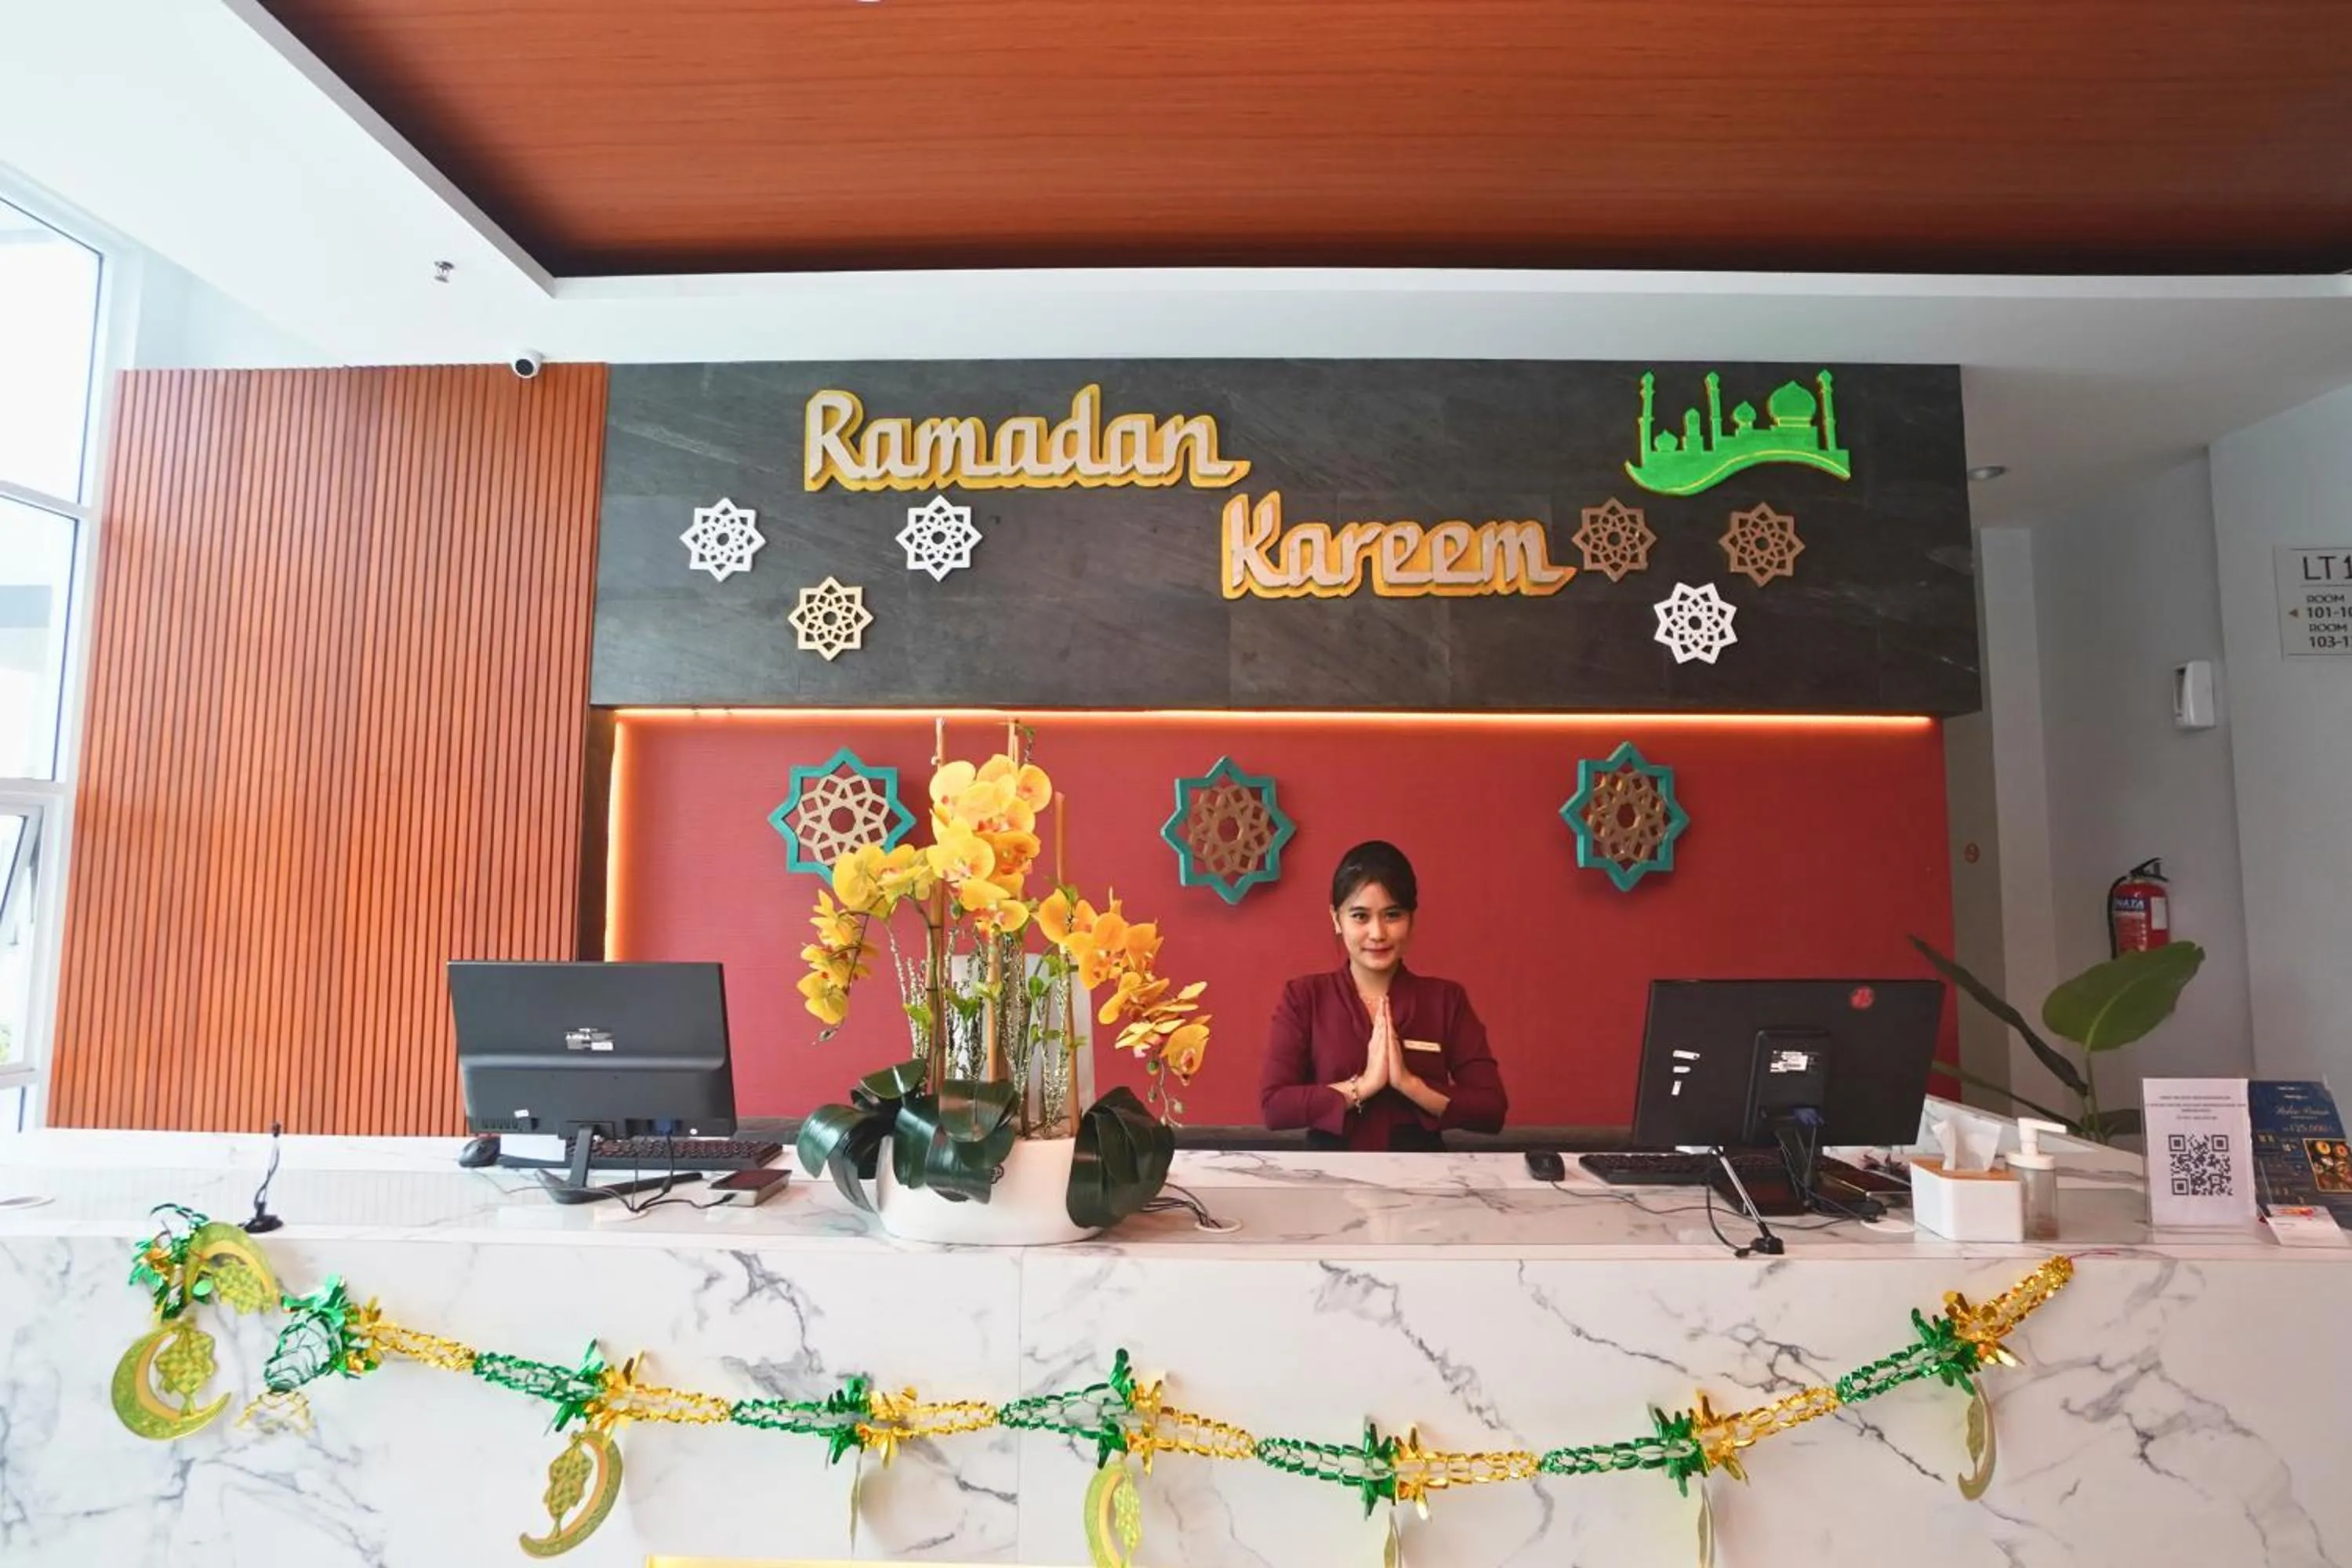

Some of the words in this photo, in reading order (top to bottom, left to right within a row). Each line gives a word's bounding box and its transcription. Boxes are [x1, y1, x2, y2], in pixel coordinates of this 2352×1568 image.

[805, 383, 1250, 491] Ramadan
[1222, 491, 1576, 599] Kareem
[2303, 556, 2337, 580] LT
[2307, 594, 2345, 604] ROOM
[2309, 623, 2348, 633] ROOM
